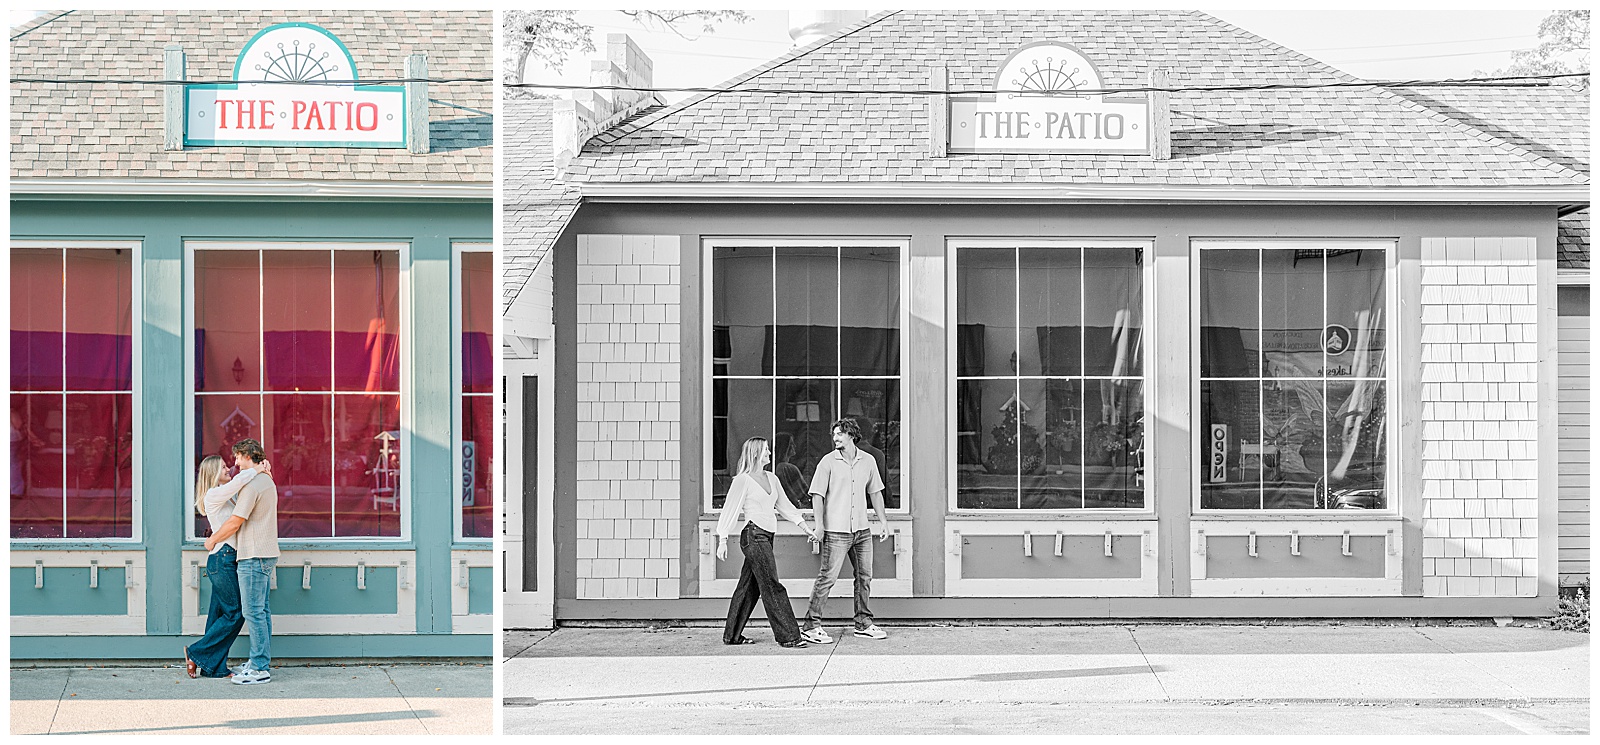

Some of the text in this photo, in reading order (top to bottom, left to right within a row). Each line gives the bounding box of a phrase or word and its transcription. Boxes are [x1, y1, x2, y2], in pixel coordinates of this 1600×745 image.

[214, 100, 378, 131] THE PATIO
[975, 112, 1124, 139] THE PATIO
